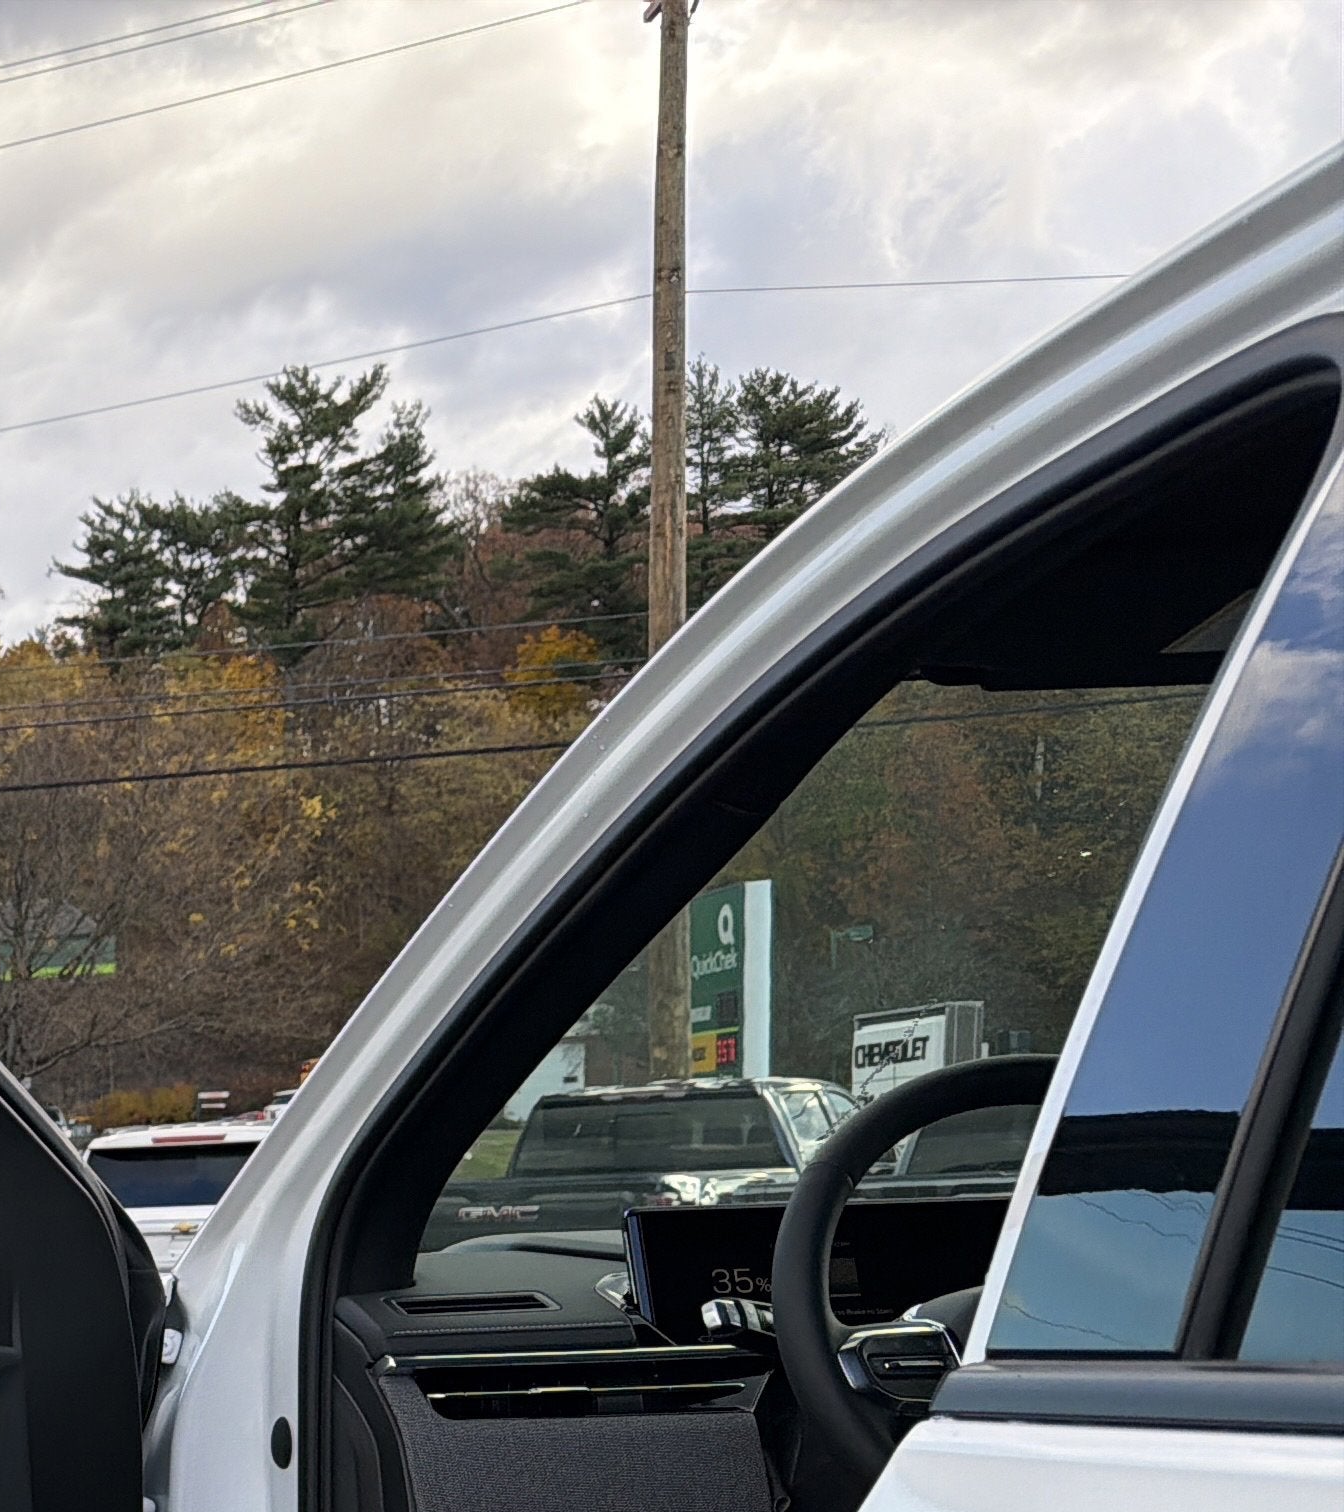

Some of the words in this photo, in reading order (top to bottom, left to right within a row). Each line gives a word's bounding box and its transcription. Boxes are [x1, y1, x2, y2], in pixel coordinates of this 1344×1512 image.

[690, 948, 739, 980] QuickChek
[456, 1205, 541, 1222] GMC
[711, 1267, 773, 1294] 35%
